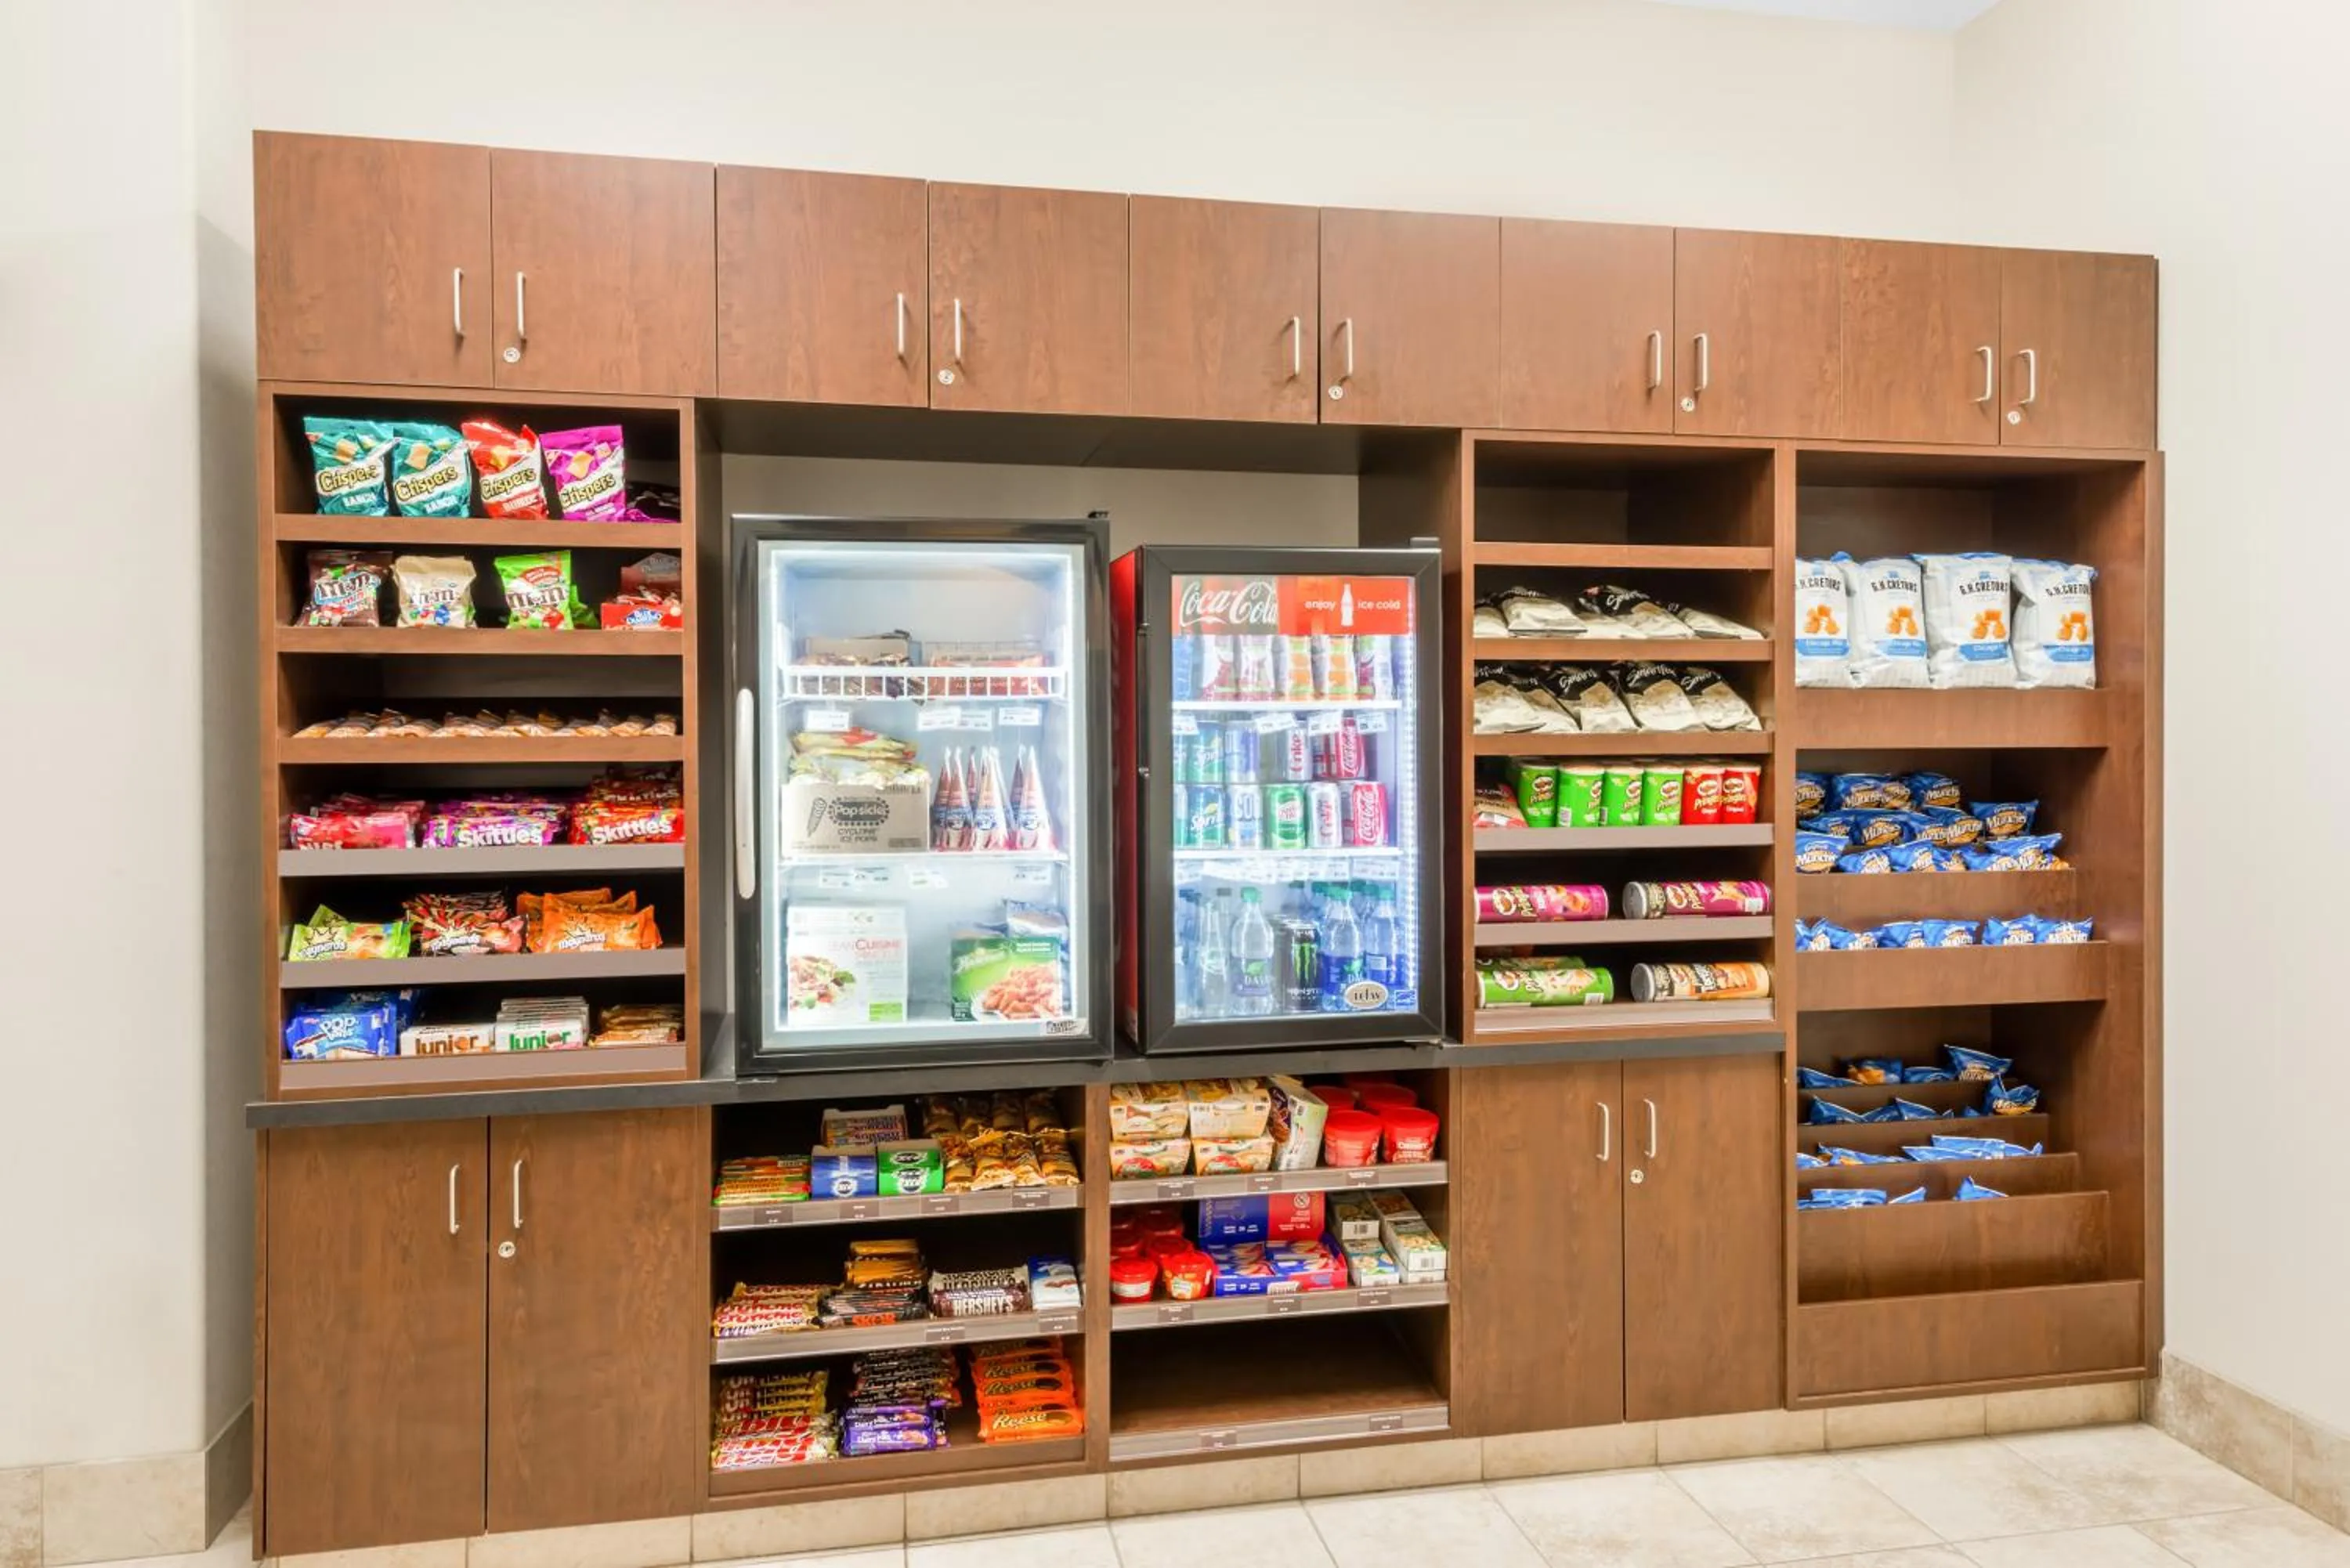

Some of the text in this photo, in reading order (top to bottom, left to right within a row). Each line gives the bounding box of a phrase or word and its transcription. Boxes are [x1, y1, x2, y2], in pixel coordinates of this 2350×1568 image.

[395, 466, 457, 501] Crispers
[481, 469, 536, 499] Crispers
[560, 473, 616, 507] Crispers
[1180, 581, 1278, 627] Coca-Cola
[1305, 601, 1335, 611] enjoy
[1358, 600, 1401, 610] ice cold
[457, 823, 543, 847] Skittles
[590, 817, 674, 844] Skittles
[953, 1295, 1014, 1317] HERSHEY'S
[851, 1312, 897, 1327] SKOR
[992, 1412, 1047, 1429] Reese
